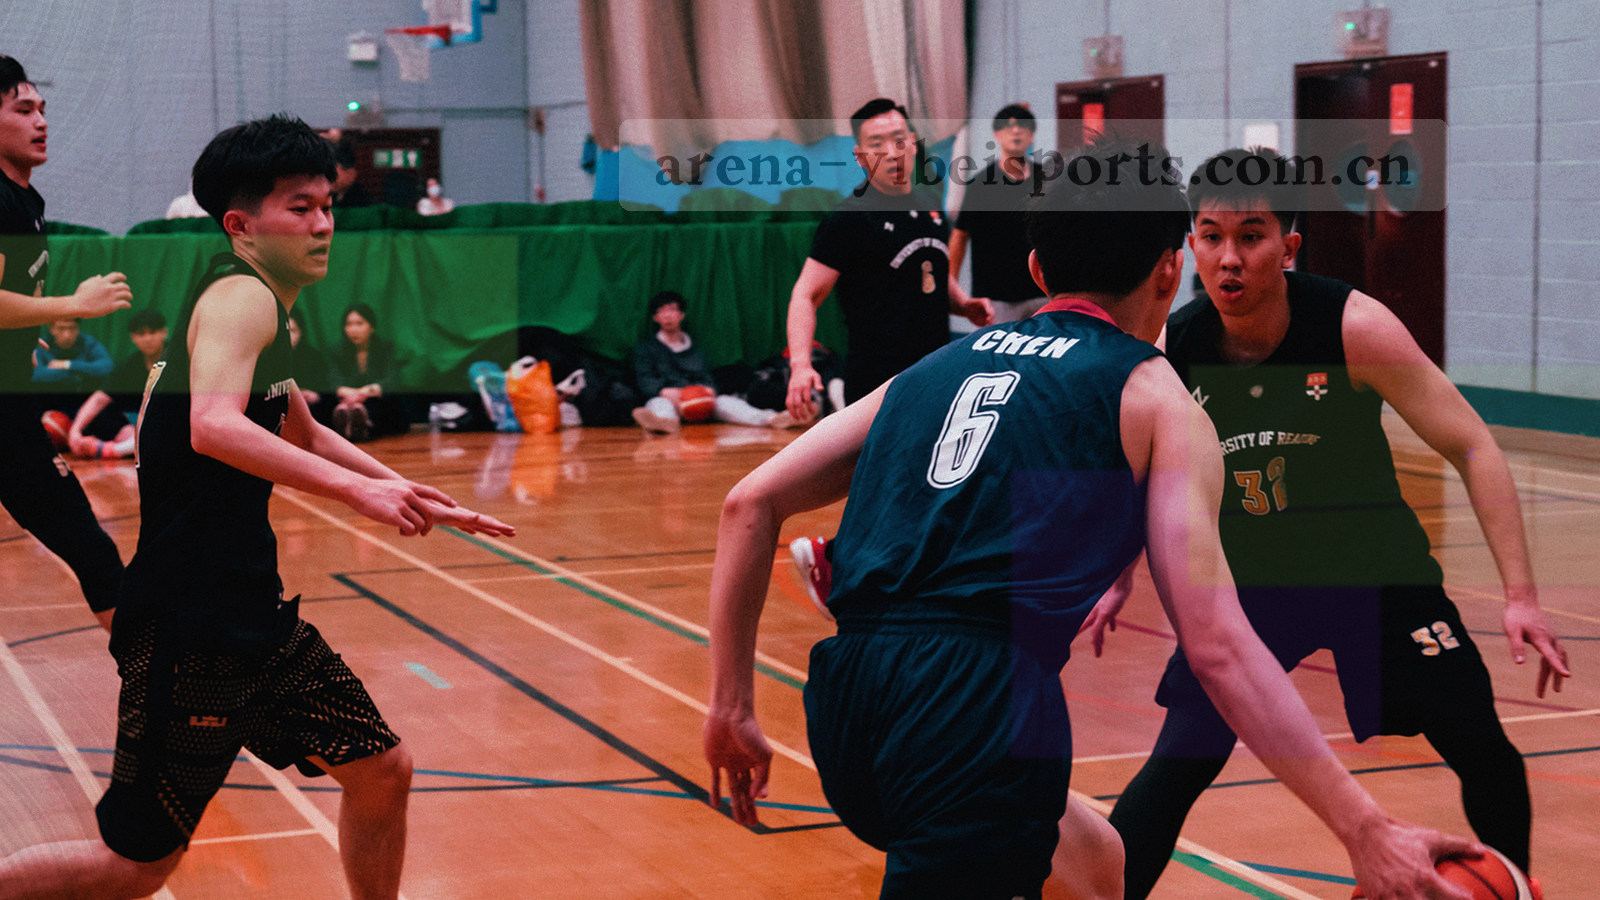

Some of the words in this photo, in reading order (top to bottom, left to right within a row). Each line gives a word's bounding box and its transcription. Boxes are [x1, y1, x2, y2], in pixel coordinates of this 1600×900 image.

[921, 260, 936, 293] 6
[972, 329, 1081, 359] CHEN
[926, 370, 1021, 489] 6
[1220, 433, 1256, 456] RSITY
[1258, 431, 1275, 446] OF
[1410, 620, 1460, 656] 32
